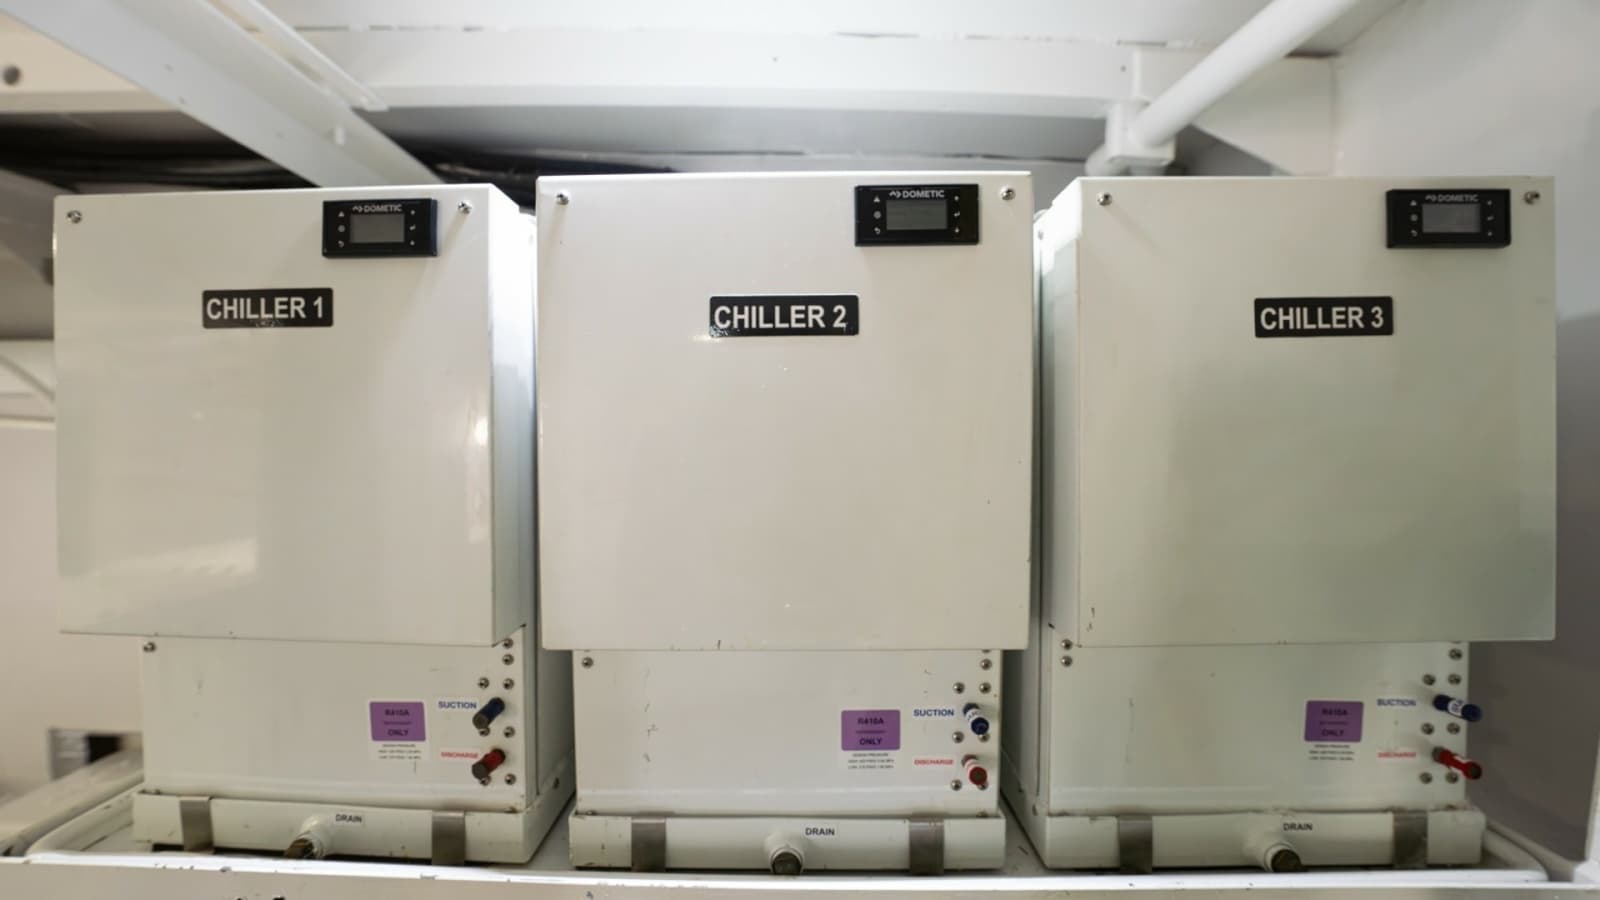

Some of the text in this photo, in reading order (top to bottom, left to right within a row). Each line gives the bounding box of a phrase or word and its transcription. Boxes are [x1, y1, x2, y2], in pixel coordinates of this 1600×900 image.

[902, 190, 945, 199] DOMETIC
[1437, 194, 1479, 203] DOMETIC
[363, 204, 402, 213] DOMETIC
[206, 296, 323, 320] CHILLER 1
[714, 304, 848, 329] CHILLER 2
[1260, 305, 1384, 330] CHILLER 3
[438, 701, 477, 709] SUCTION
[1376, 698, 1417, 707] SUCTION
[913, 708, 955, 717] SUCTION
[387, 729, 409, 737] ONLY
[859, 737, 883, 746] ONLY
[335, 813, 363, 824] DRAIN
[805, 826, 835, 837] DRAIN
[1283, 822, 1313, 832] DRAIN
